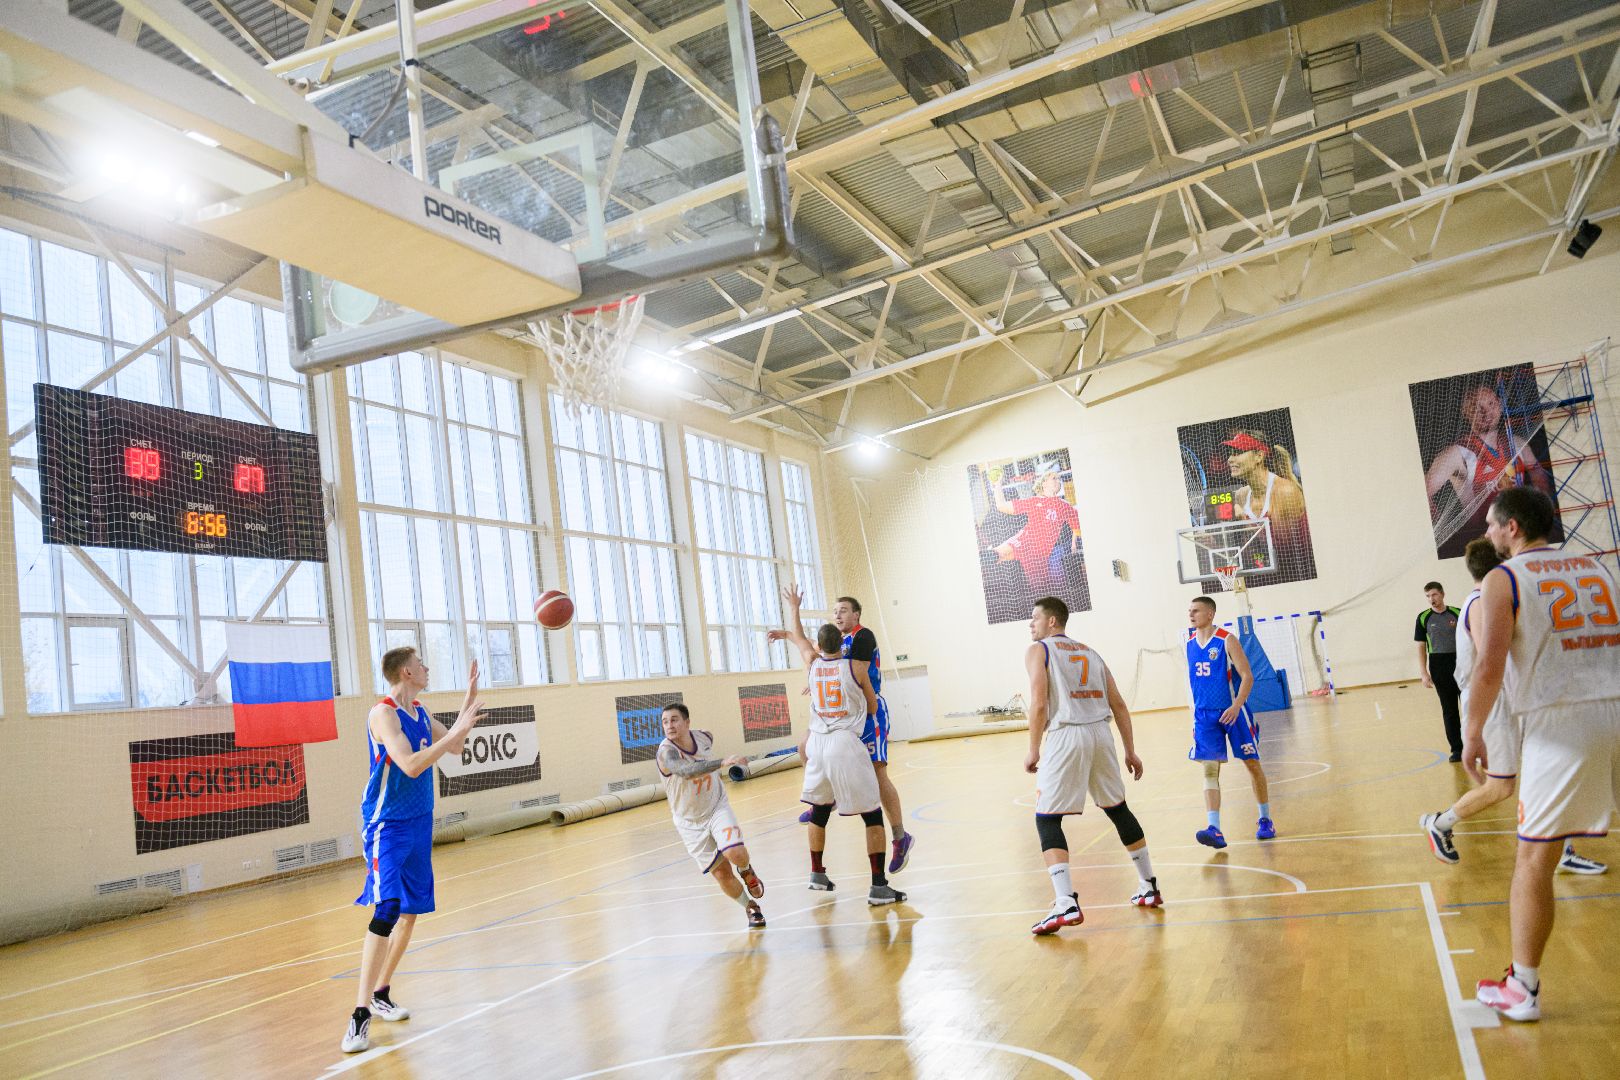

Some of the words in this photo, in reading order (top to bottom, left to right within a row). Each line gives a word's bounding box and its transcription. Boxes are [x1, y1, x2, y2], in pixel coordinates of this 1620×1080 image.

[181, 451, 213, 463] ПЕРИОД
[194, 462, 203, 480] 3
[187, 502, 215, 512] ВРЕМЯ
[1210, 492, 1232, 505] 8:56
[129, 511, 157, 522] ФОЛЫ
[1537, 574, 1620, 633] 23
[1069, 654, 1089, 687] 7
[1195, 661, 1211, 677] 35
[815, 680, 843, 709] 15
[461, 732, 518, 767] БОКС
[1240, 742, 1256, 756] 35
[147, 758, 297, 804] БАСКЕТБОЛ
[692, 774, 712, 795] 77
[722, 825, 741, 841] 77
